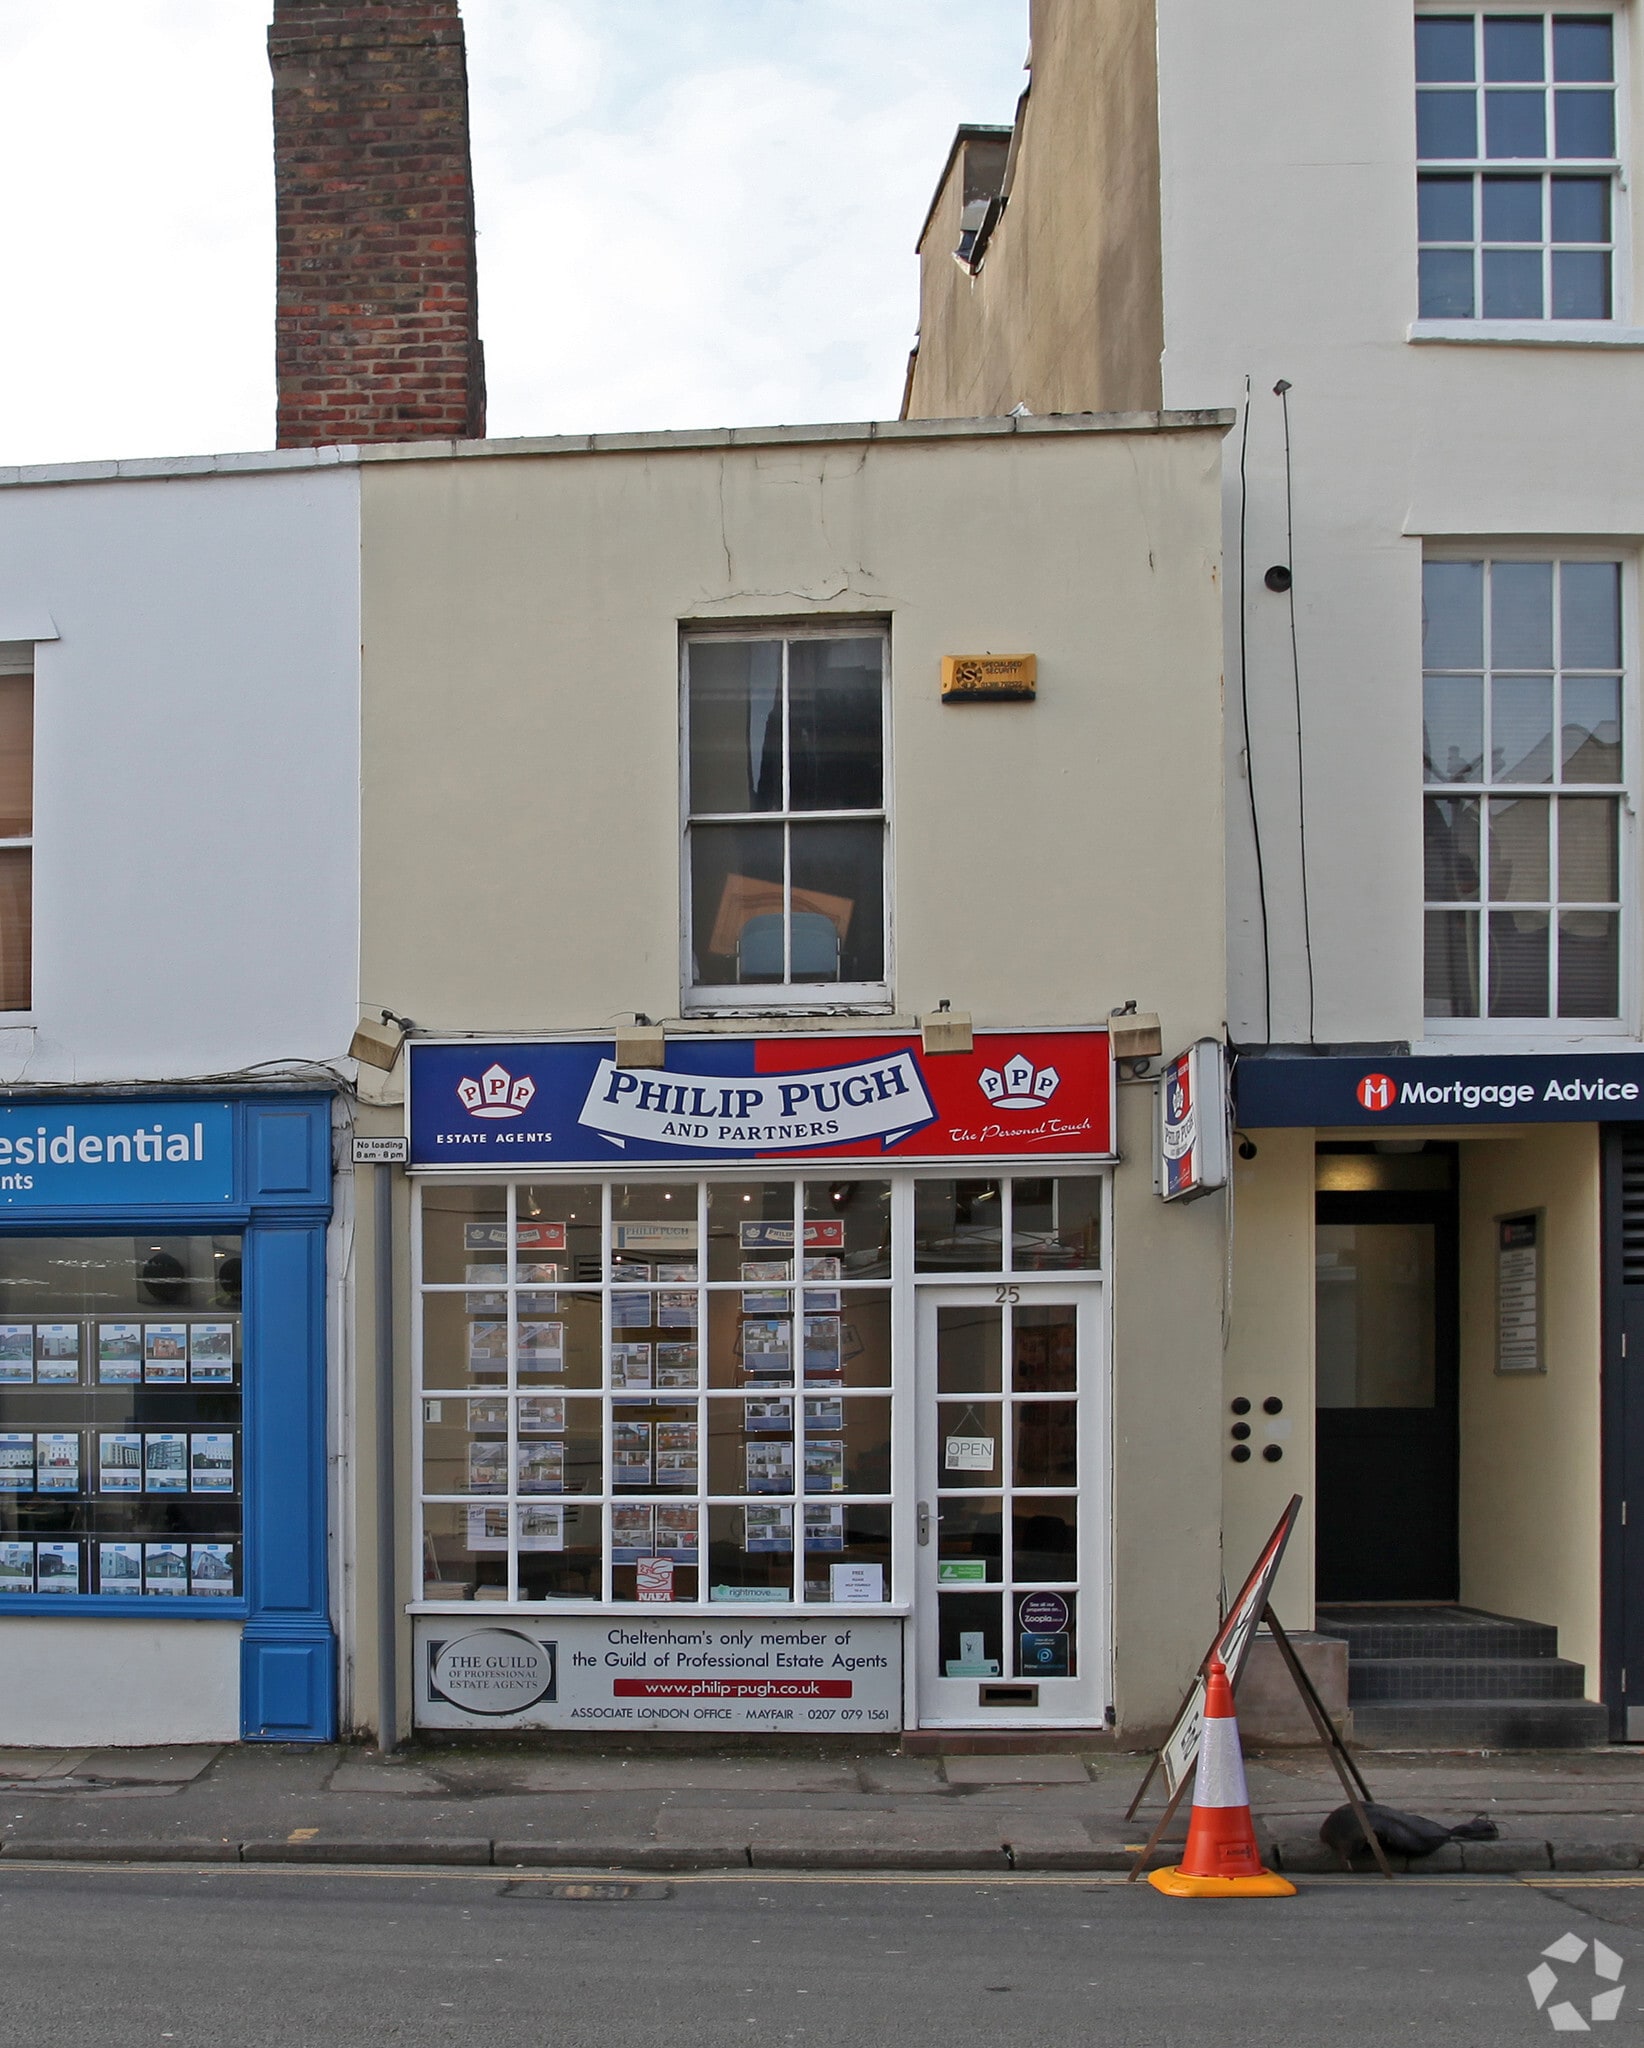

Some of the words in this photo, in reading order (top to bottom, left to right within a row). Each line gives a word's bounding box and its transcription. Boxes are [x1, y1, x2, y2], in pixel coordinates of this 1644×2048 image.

[603, 1071, 763, 1118] PHILIP
[778, 1065, 909, 1117] PUGH
[1400, 1081, 1535, 1108] Mortgage
[1543, 1078, 1639, 1101] Advice
[662, 1122, 708, 1138] AND
[718, 1120, 839, 1140] PARTNERS
[949, 1128, 977, 1142] The
[980, 1122, 1046, 1142] Personal
[1048, 1118, 1092, 1133] Touch
[357, 1141, 370, 1149] No
[372, 1141, 403, 1149] loading
[436, 1134, 487, 1144] ESTATE
[496, 1133, 552, 1143] AGENTS
[1, 1173, 33, 1189] nts
[660, 1227, 688, 1235] PUGH
[995, 1286, 1020, 1303] 25
[948, 1442, 992, 1456] OPEN
[608, 1629, 713, 1645] Cheltenham's
[720, 1630, 753, 1648] only
[761, 1630, 827, 1645] member
[835, 1630, 851, 1645] of
[449, 1656, 481, 1668] THE
[486, 1656, 537, 1668] GUILD
[573, 1651, 597, 1667] the
[604, 1652, 646, 1667] Guild
[654, 1652, 670, 1667] of
[677, 1652, 769, 1667] Professional
[776, 1653, 824, 1667] Estate
[832, 1653, 887, 1671] Agents
[450, 1681, 490, 1689] ESTATE
[493, 1681, 538, 1689] AGENTS
[645, 1681, 820, 1696] www.philip-pugh.co.uk
[571, 1708, 633, 1718] ASSOCIATE
[637, 1708, 689, 1719] LONDON
[694, 1709, 732, 1719] OFFICE
[745, 1709, 793, 1719] MAYFAIR
[807, 1709, 836, 1720] 0207
[841, 1709, 863, 1720] 079
[868, 1710, 889, 1720] 1561
